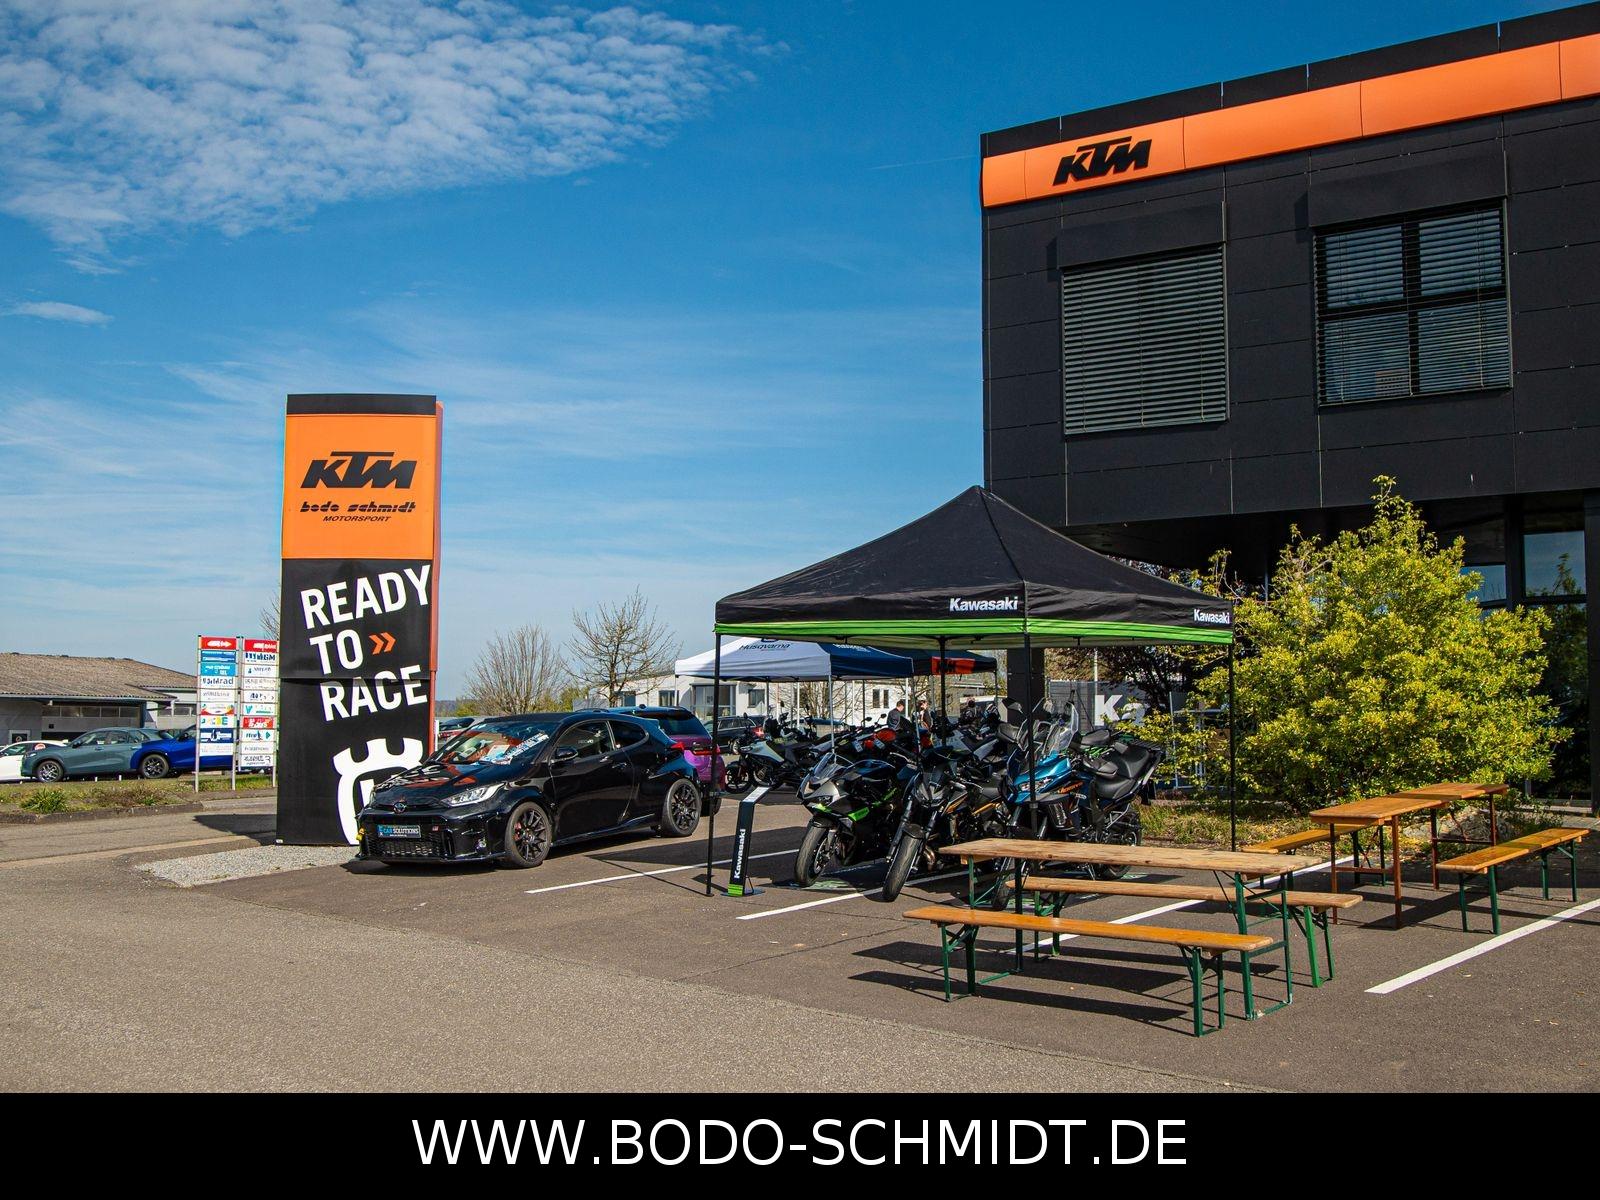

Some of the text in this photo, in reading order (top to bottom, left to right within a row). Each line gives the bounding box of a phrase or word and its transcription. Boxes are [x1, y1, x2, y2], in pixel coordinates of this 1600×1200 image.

[1053, 136, 1152, 186] KTM
[300, 451, 418, 489] KTM
[300, 501, 417, 513] bodo schmidt
[300, 564, 431, 629] READY
[949, 596, 1019, 612] Kawasaki
[1193, 608, 1230, 624] Kawasaki
[309, 629, 364, 675] TO
[741, 643, 791, 651] Husqvarna
[320, 664, 428, 722] RACE
[733, 828, 747, 879] Kawasaki
